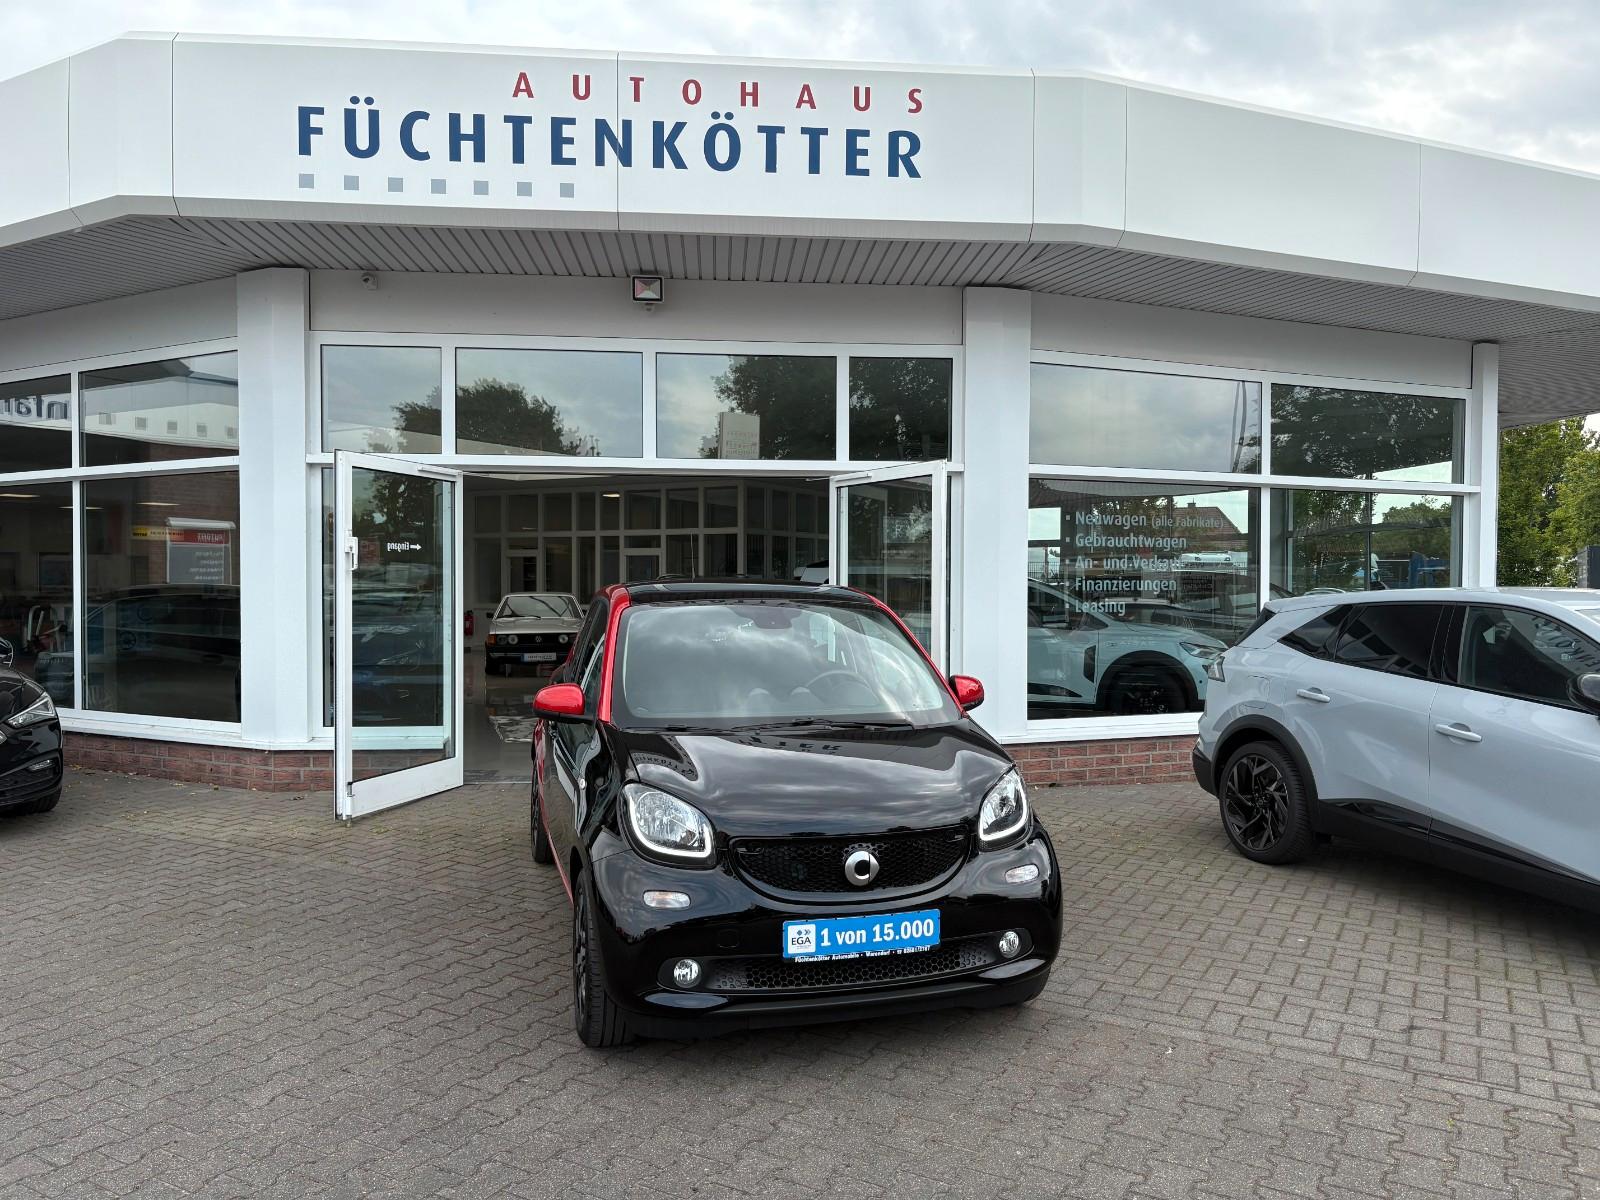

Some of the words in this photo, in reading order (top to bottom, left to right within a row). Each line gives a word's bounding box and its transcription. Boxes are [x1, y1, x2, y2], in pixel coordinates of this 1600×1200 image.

[512, 71, 924, 114] AUTOHAUS
[298, 96, 923, 179] FÜCHTENKÖTTER
[1075, 511, 1147, 530] Neuwagen
[1151, 515, 1174, 528] (alle
[1075, 533, 1187, 552] Gebrauchtwagen
[1103, 554, 1128, 570] und
[1075, 577, 1177, 595] Finanzierungen
[1075, 600, 1126, 617] Leasing
[791, 936, 812, 946] EGA
[820, 927, 832, 947] 1
[835, 928, 867, 946] von
[872, 918, 935, 943] 15.000
